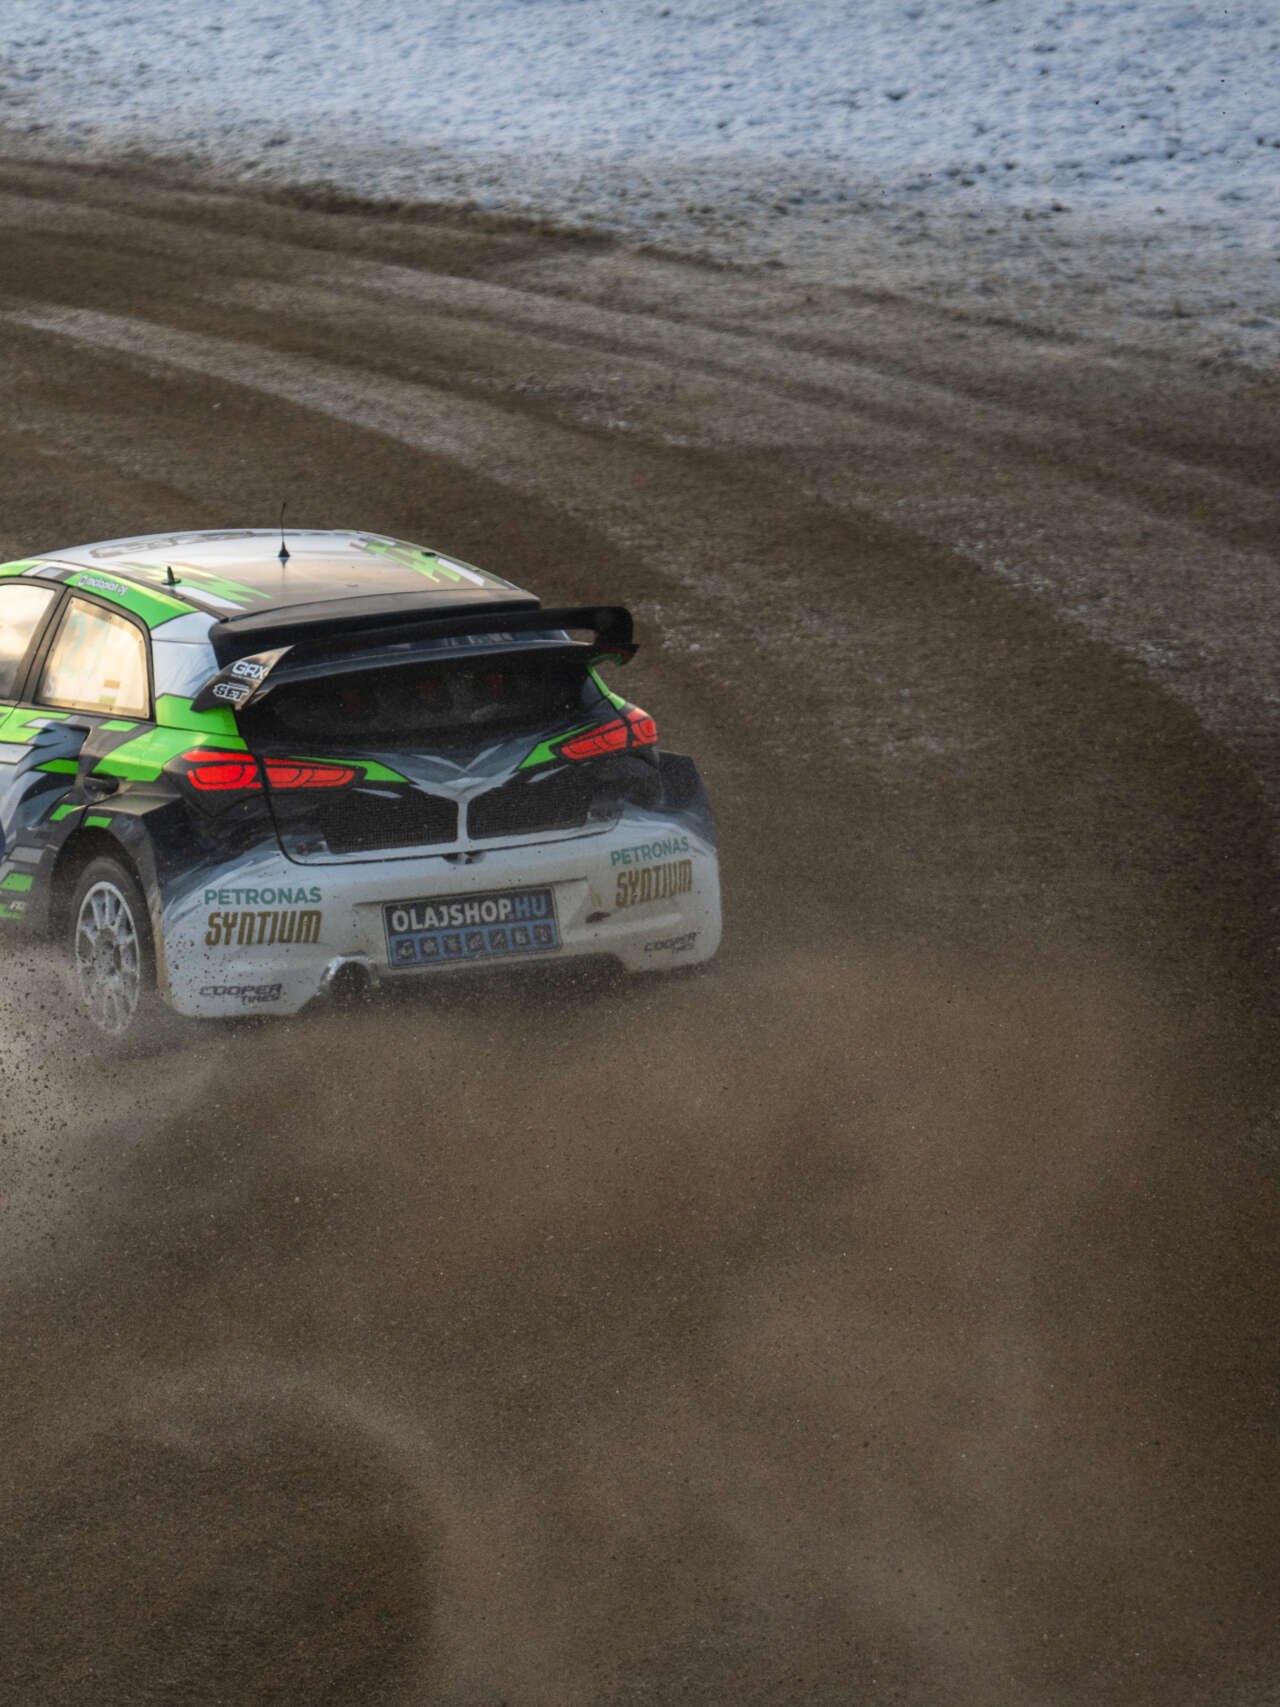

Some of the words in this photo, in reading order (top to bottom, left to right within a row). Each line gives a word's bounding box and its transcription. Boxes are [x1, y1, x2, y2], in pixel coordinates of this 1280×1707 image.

[232, 661, 267, 680] GRX
[213, 683, 250, 701] SET
[610, 836, 689, 866] PETRONAS
[204, 886, 323, 905] PETRONAS
[615, 859, 692, 908] SYNTIUM
[391, 896, 547, 932] OLAJSHOP.HU
[205, 910, 322, 946] SYNTIUM
[200, 984, 282, 996] COOPER
